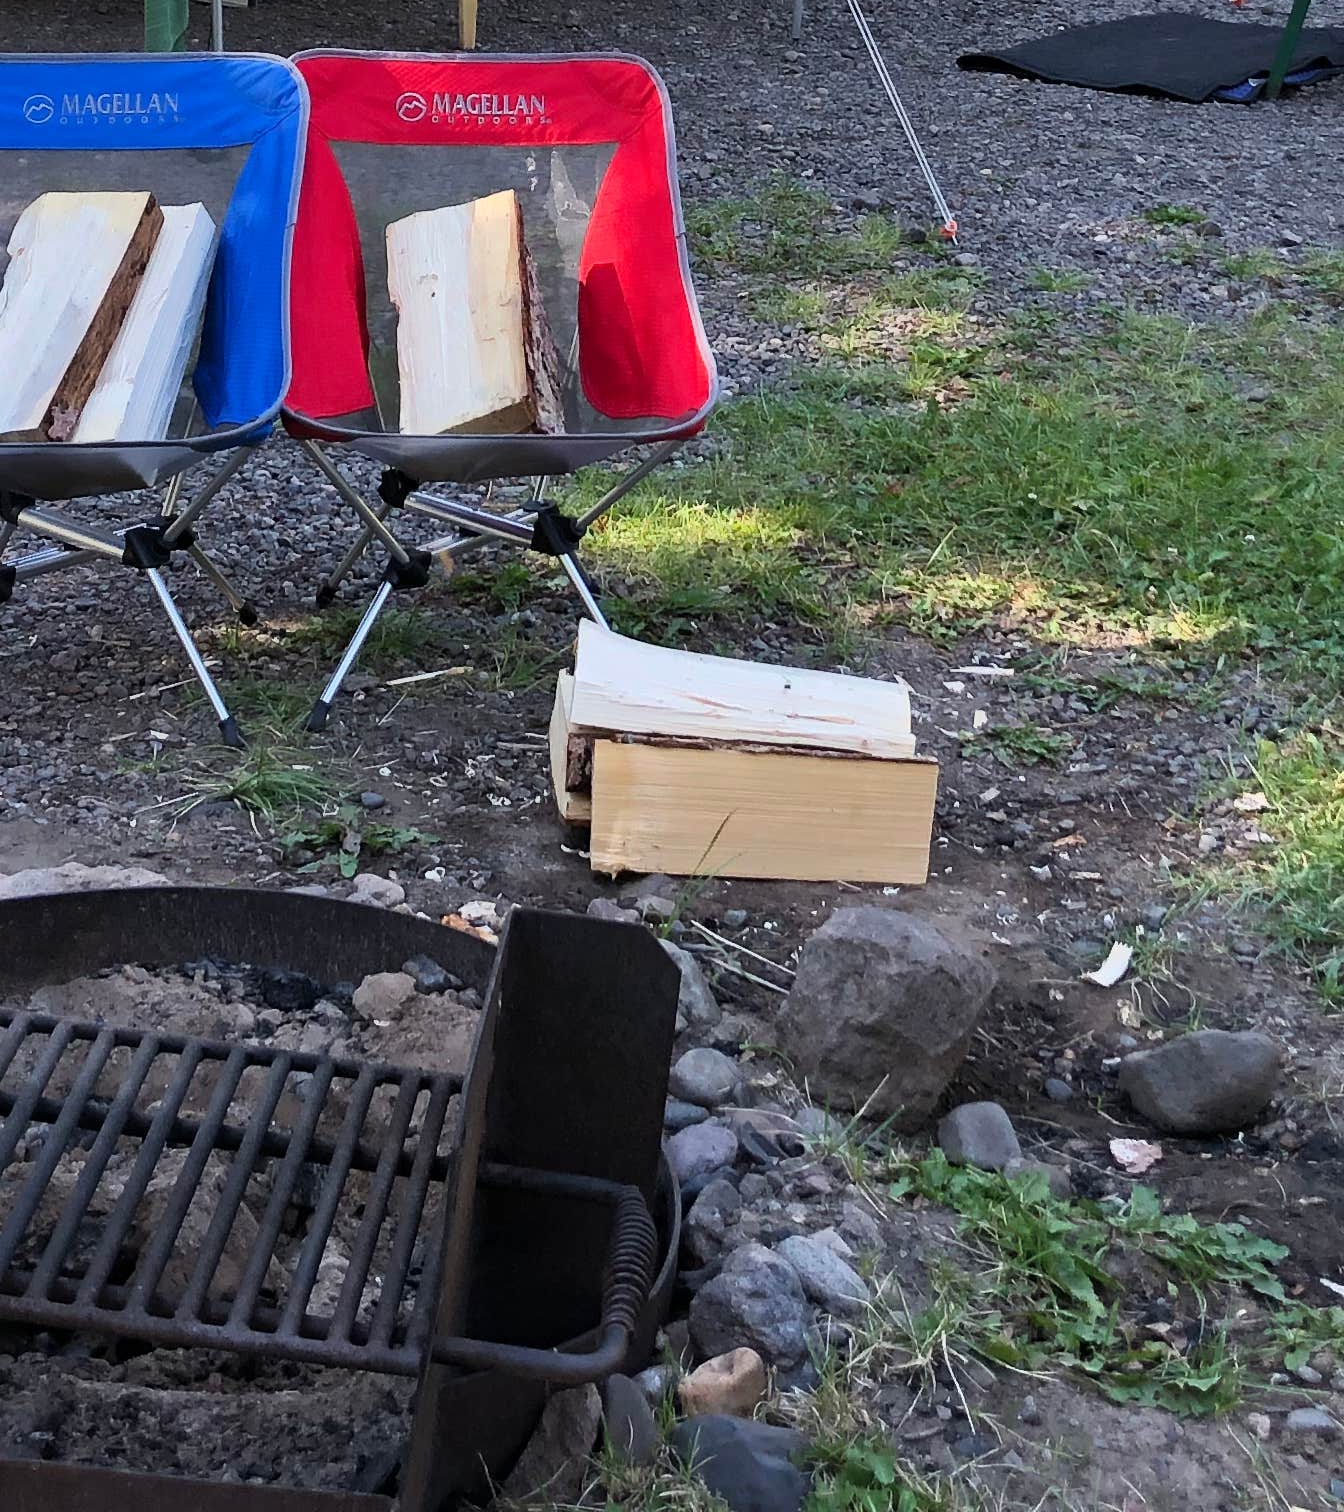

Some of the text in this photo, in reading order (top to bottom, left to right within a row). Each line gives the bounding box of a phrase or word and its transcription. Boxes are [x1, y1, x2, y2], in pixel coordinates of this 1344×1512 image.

[61, 93, 179, 115] MAGELLAN
[431, 92, 546, 115] MAGELLAN
[431, 116, 548, 125] OUTDOORS
